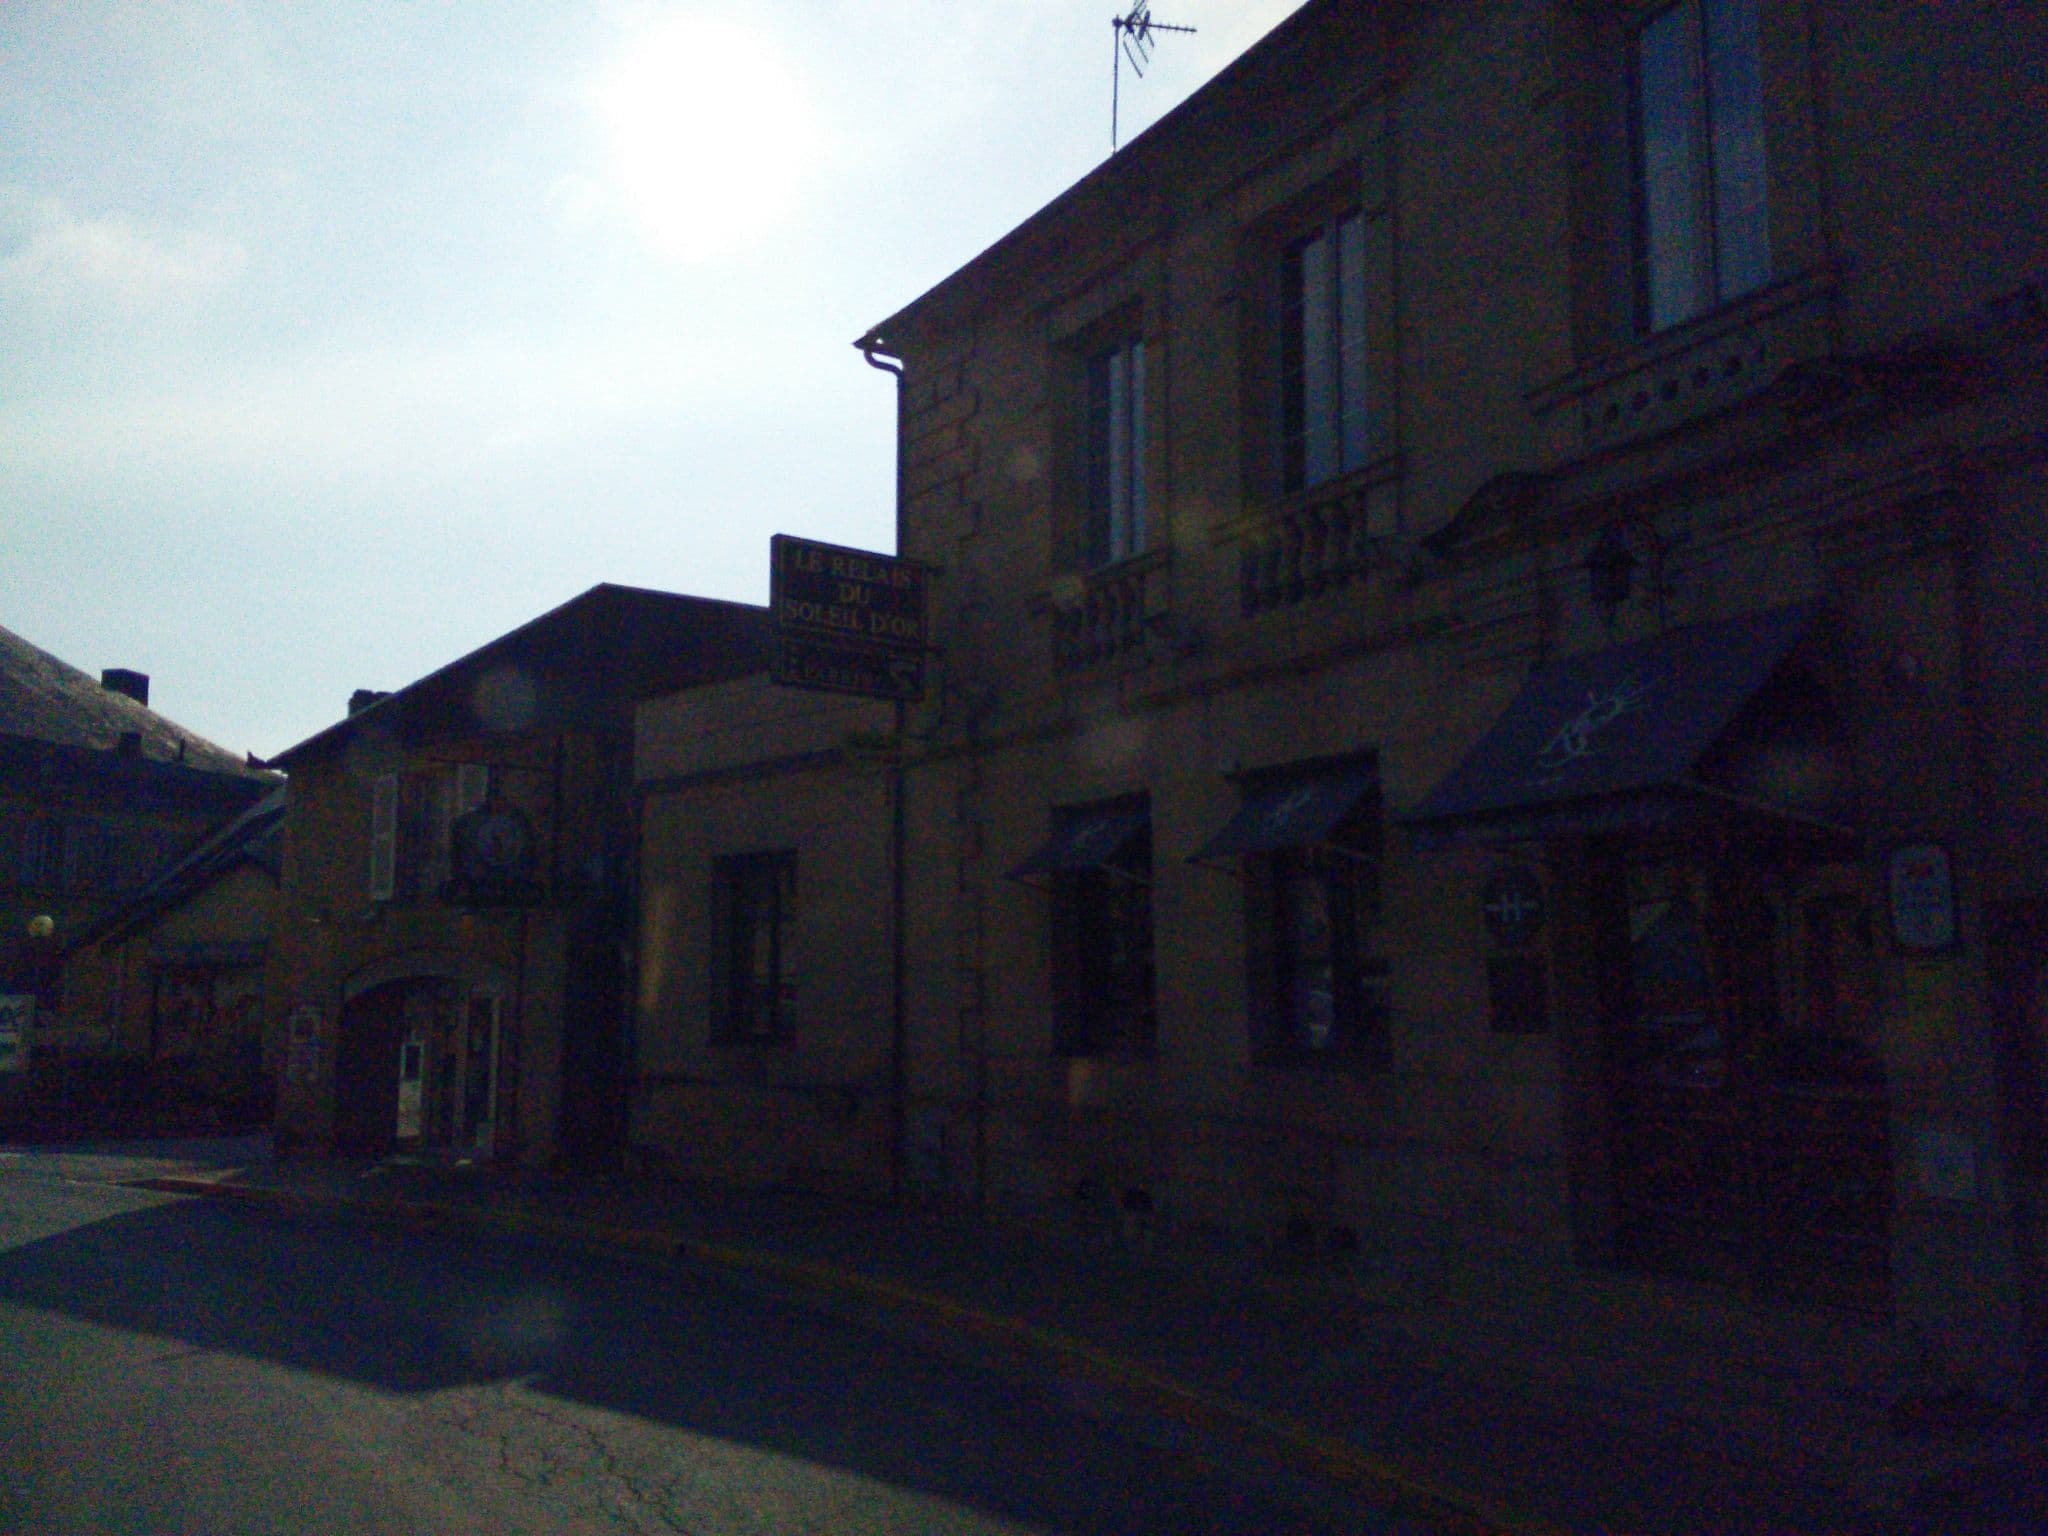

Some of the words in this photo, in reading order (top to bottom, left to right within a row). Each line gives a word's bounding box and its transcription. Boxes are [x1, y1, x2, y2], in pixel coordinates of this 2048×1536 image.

[796, 548, 824, 573] LE
[831, 555, 912, 588] RELAIS
[839, 581, 871, 606] DU
[785, 597, 864, 629] SOLEIL
[870, 611, 920, 639] D'OR
